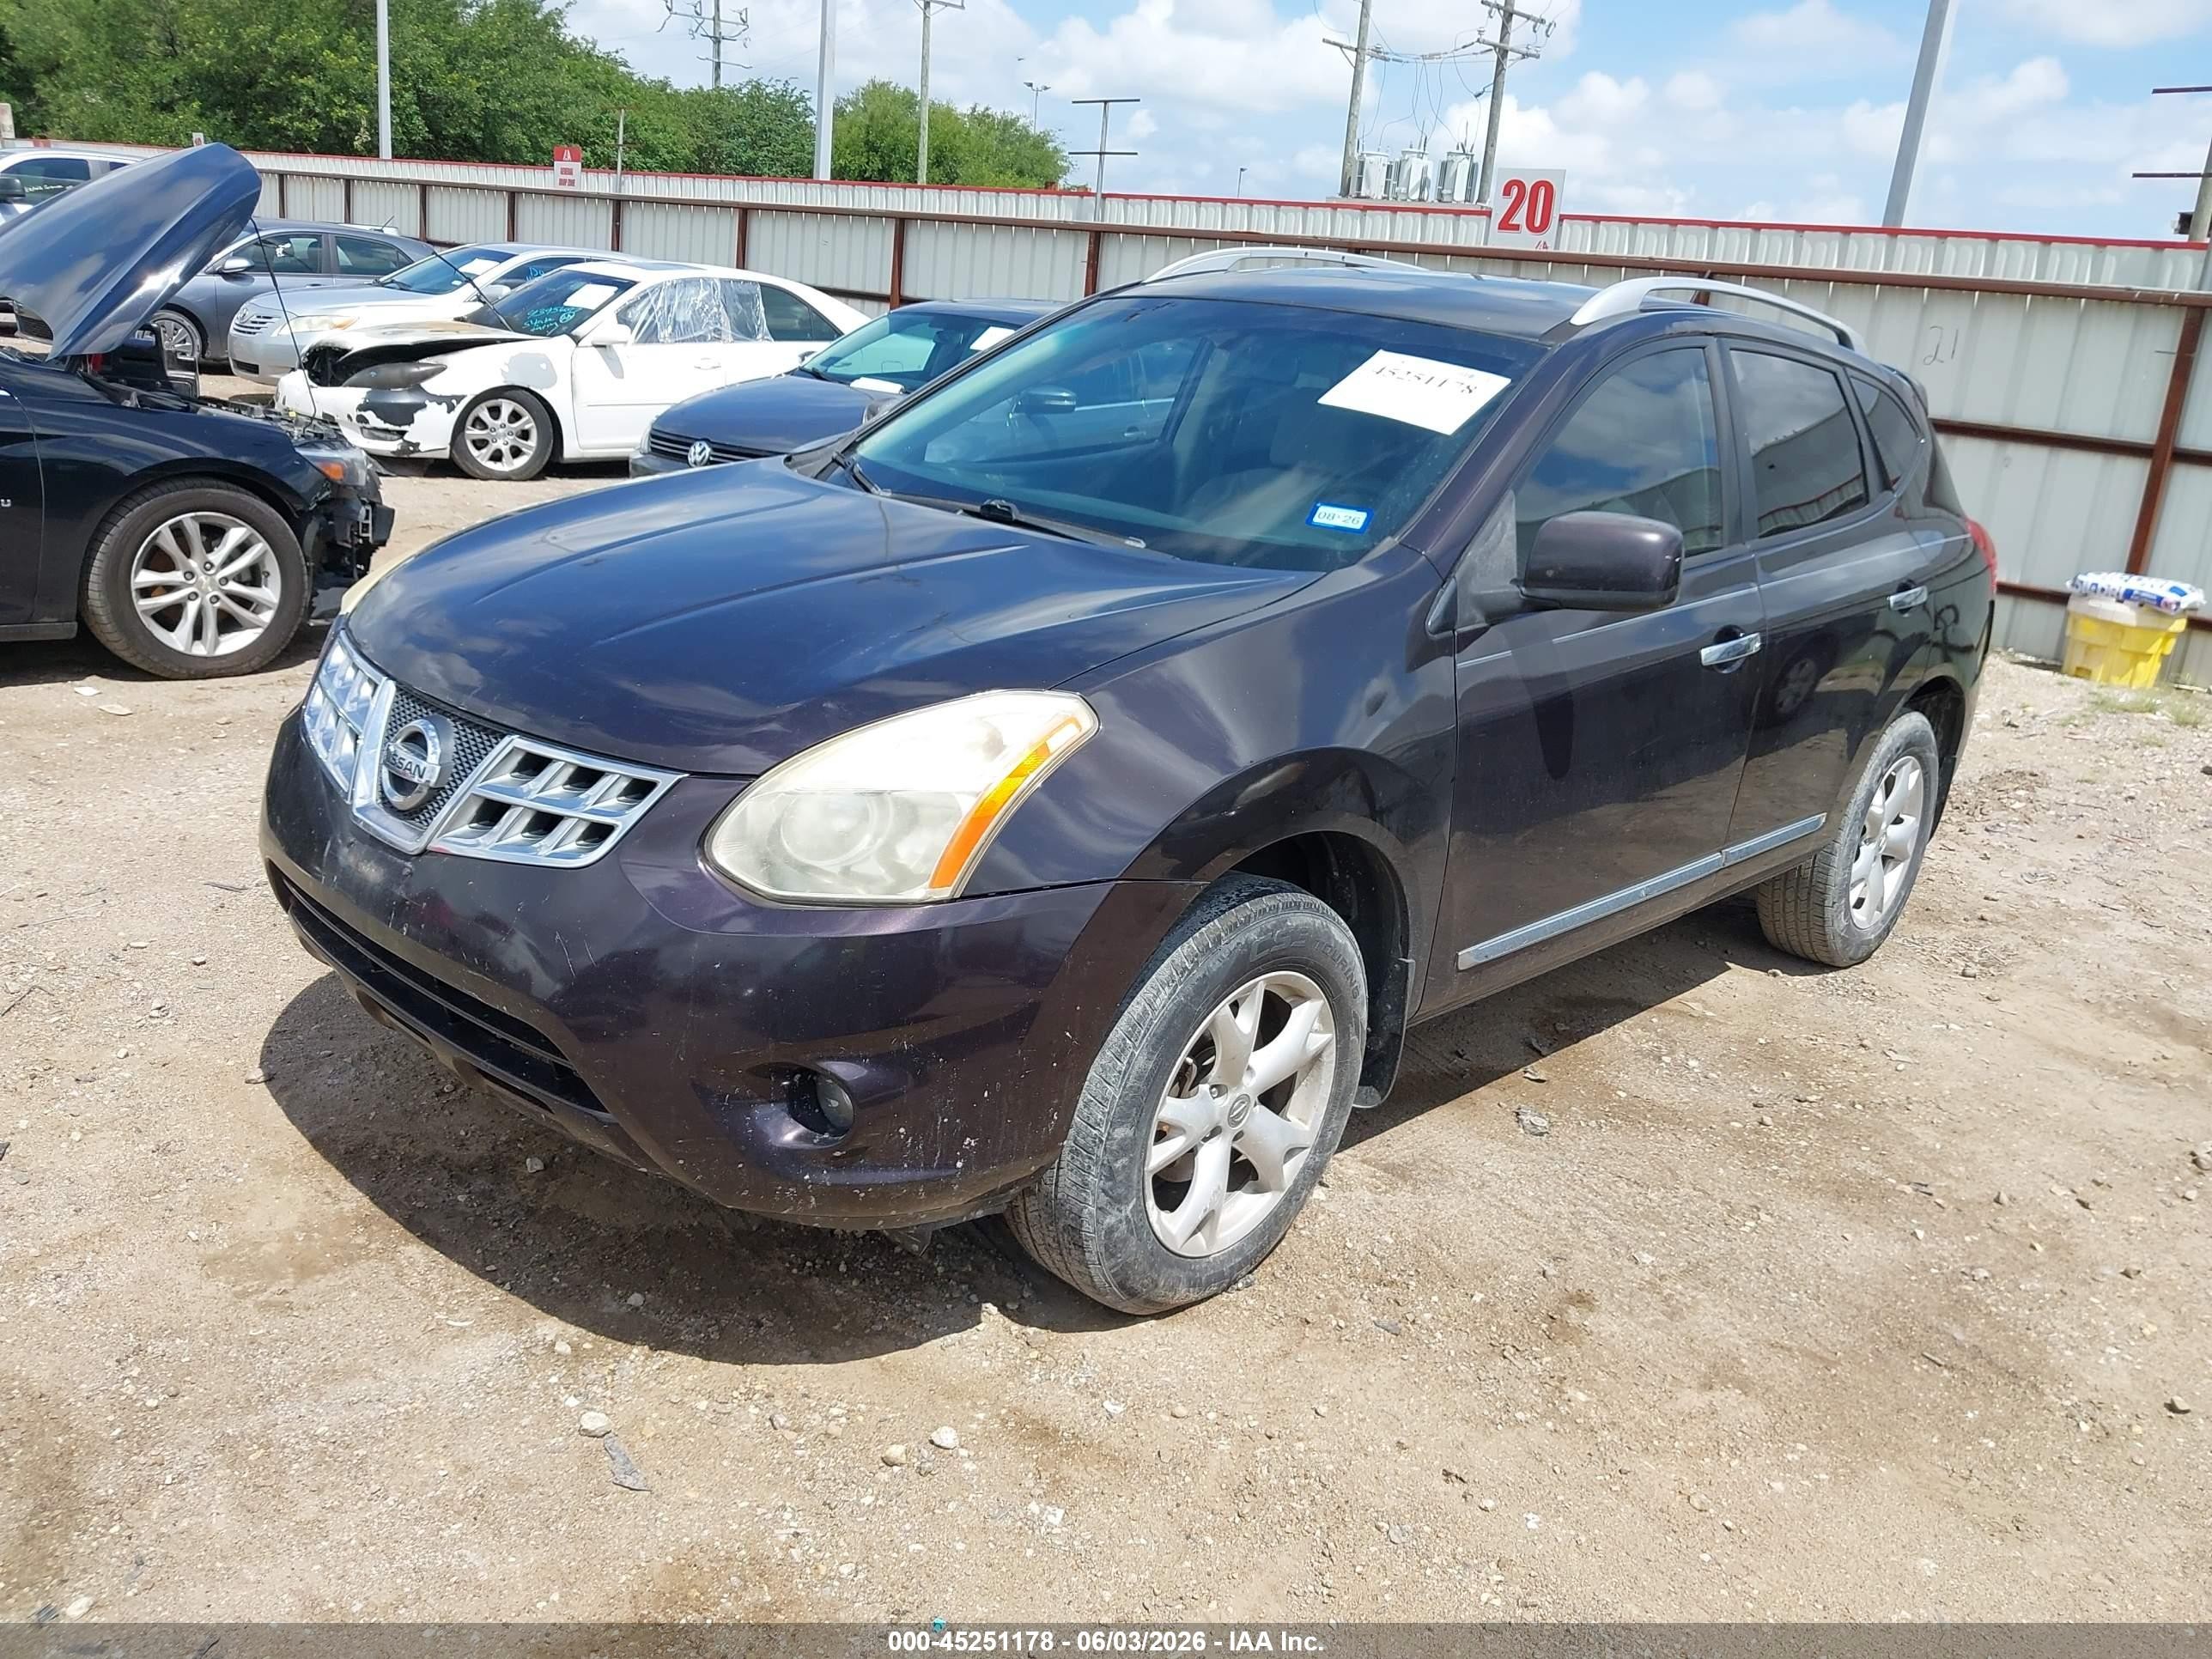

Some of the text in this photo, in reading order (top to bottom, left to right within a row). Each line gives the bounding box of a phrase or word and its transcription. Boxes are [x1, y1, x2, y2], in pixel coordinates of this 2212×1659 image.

[1498, 178, 1555, 234] 20
[1923, 325, 1960, 366] 21
[386, 750, 427, 779] SSAN
[1313, 939, 1360, 1000] TOURING
